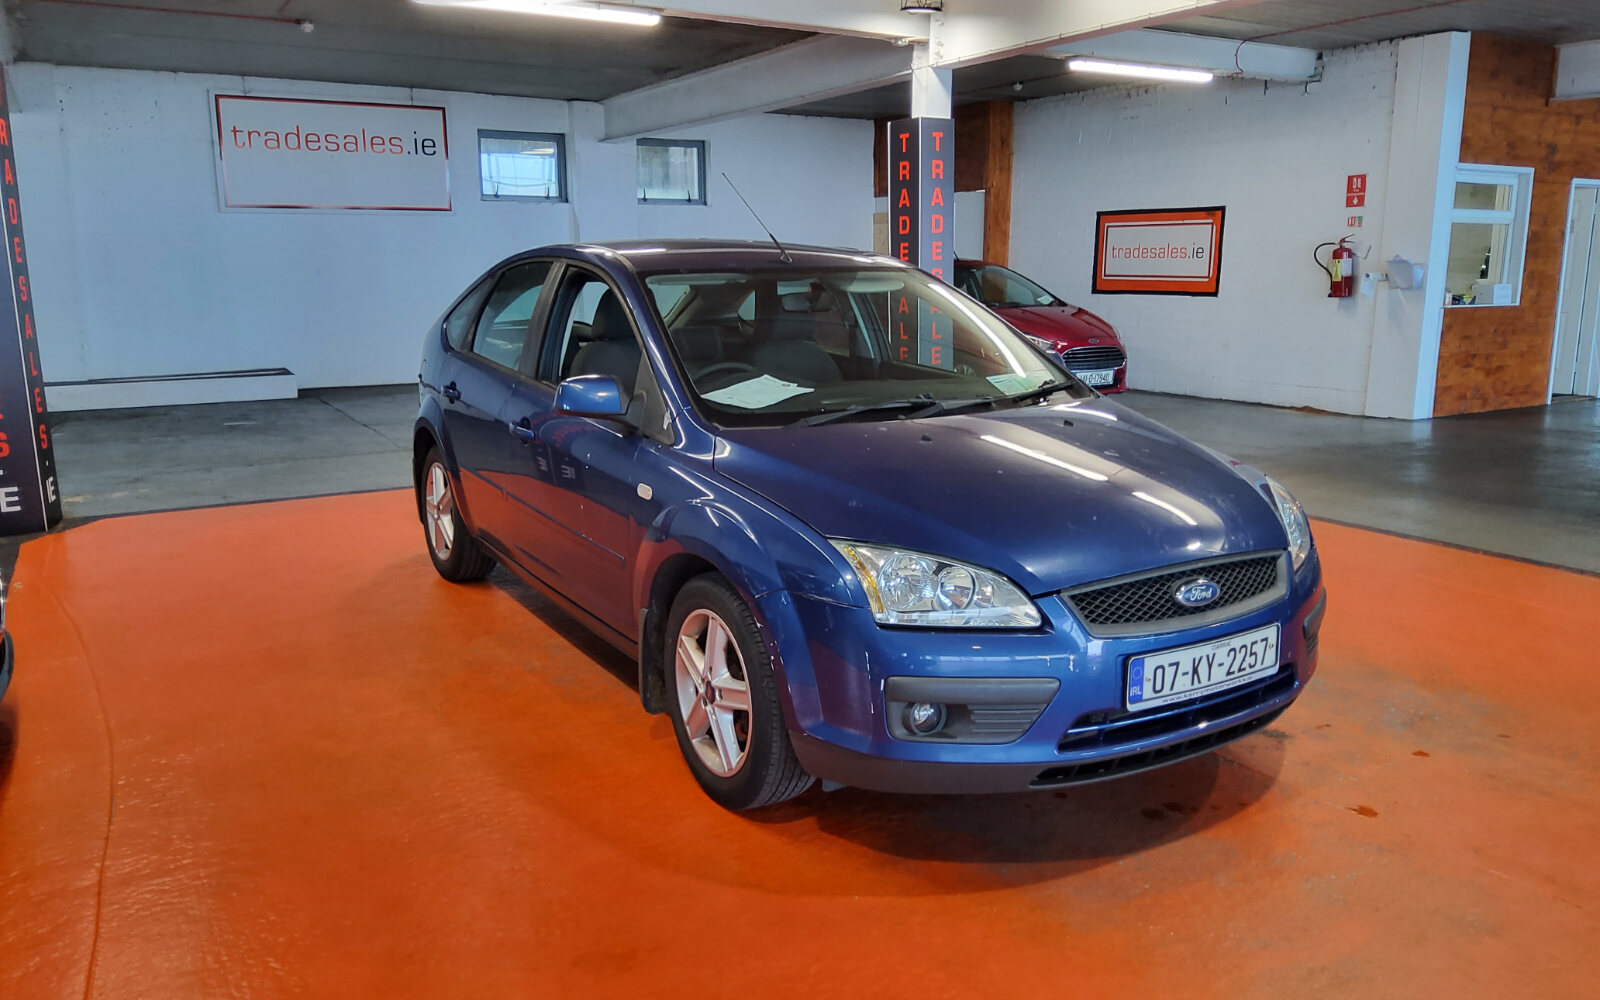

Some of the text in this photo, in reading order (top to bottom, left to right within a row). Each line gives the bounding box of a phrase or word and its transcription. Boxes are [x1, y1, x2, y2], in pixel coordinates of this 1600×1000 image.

[230, 125, 437, 156] tradesales.ie
[1111, 242, 1205, 259] tradesales.ie
[1190, 585, 1212, 601] Ford
[1152, 637, 1269, 694] 07-KY-2257
[1129, 686, 1142, 696] IRL
